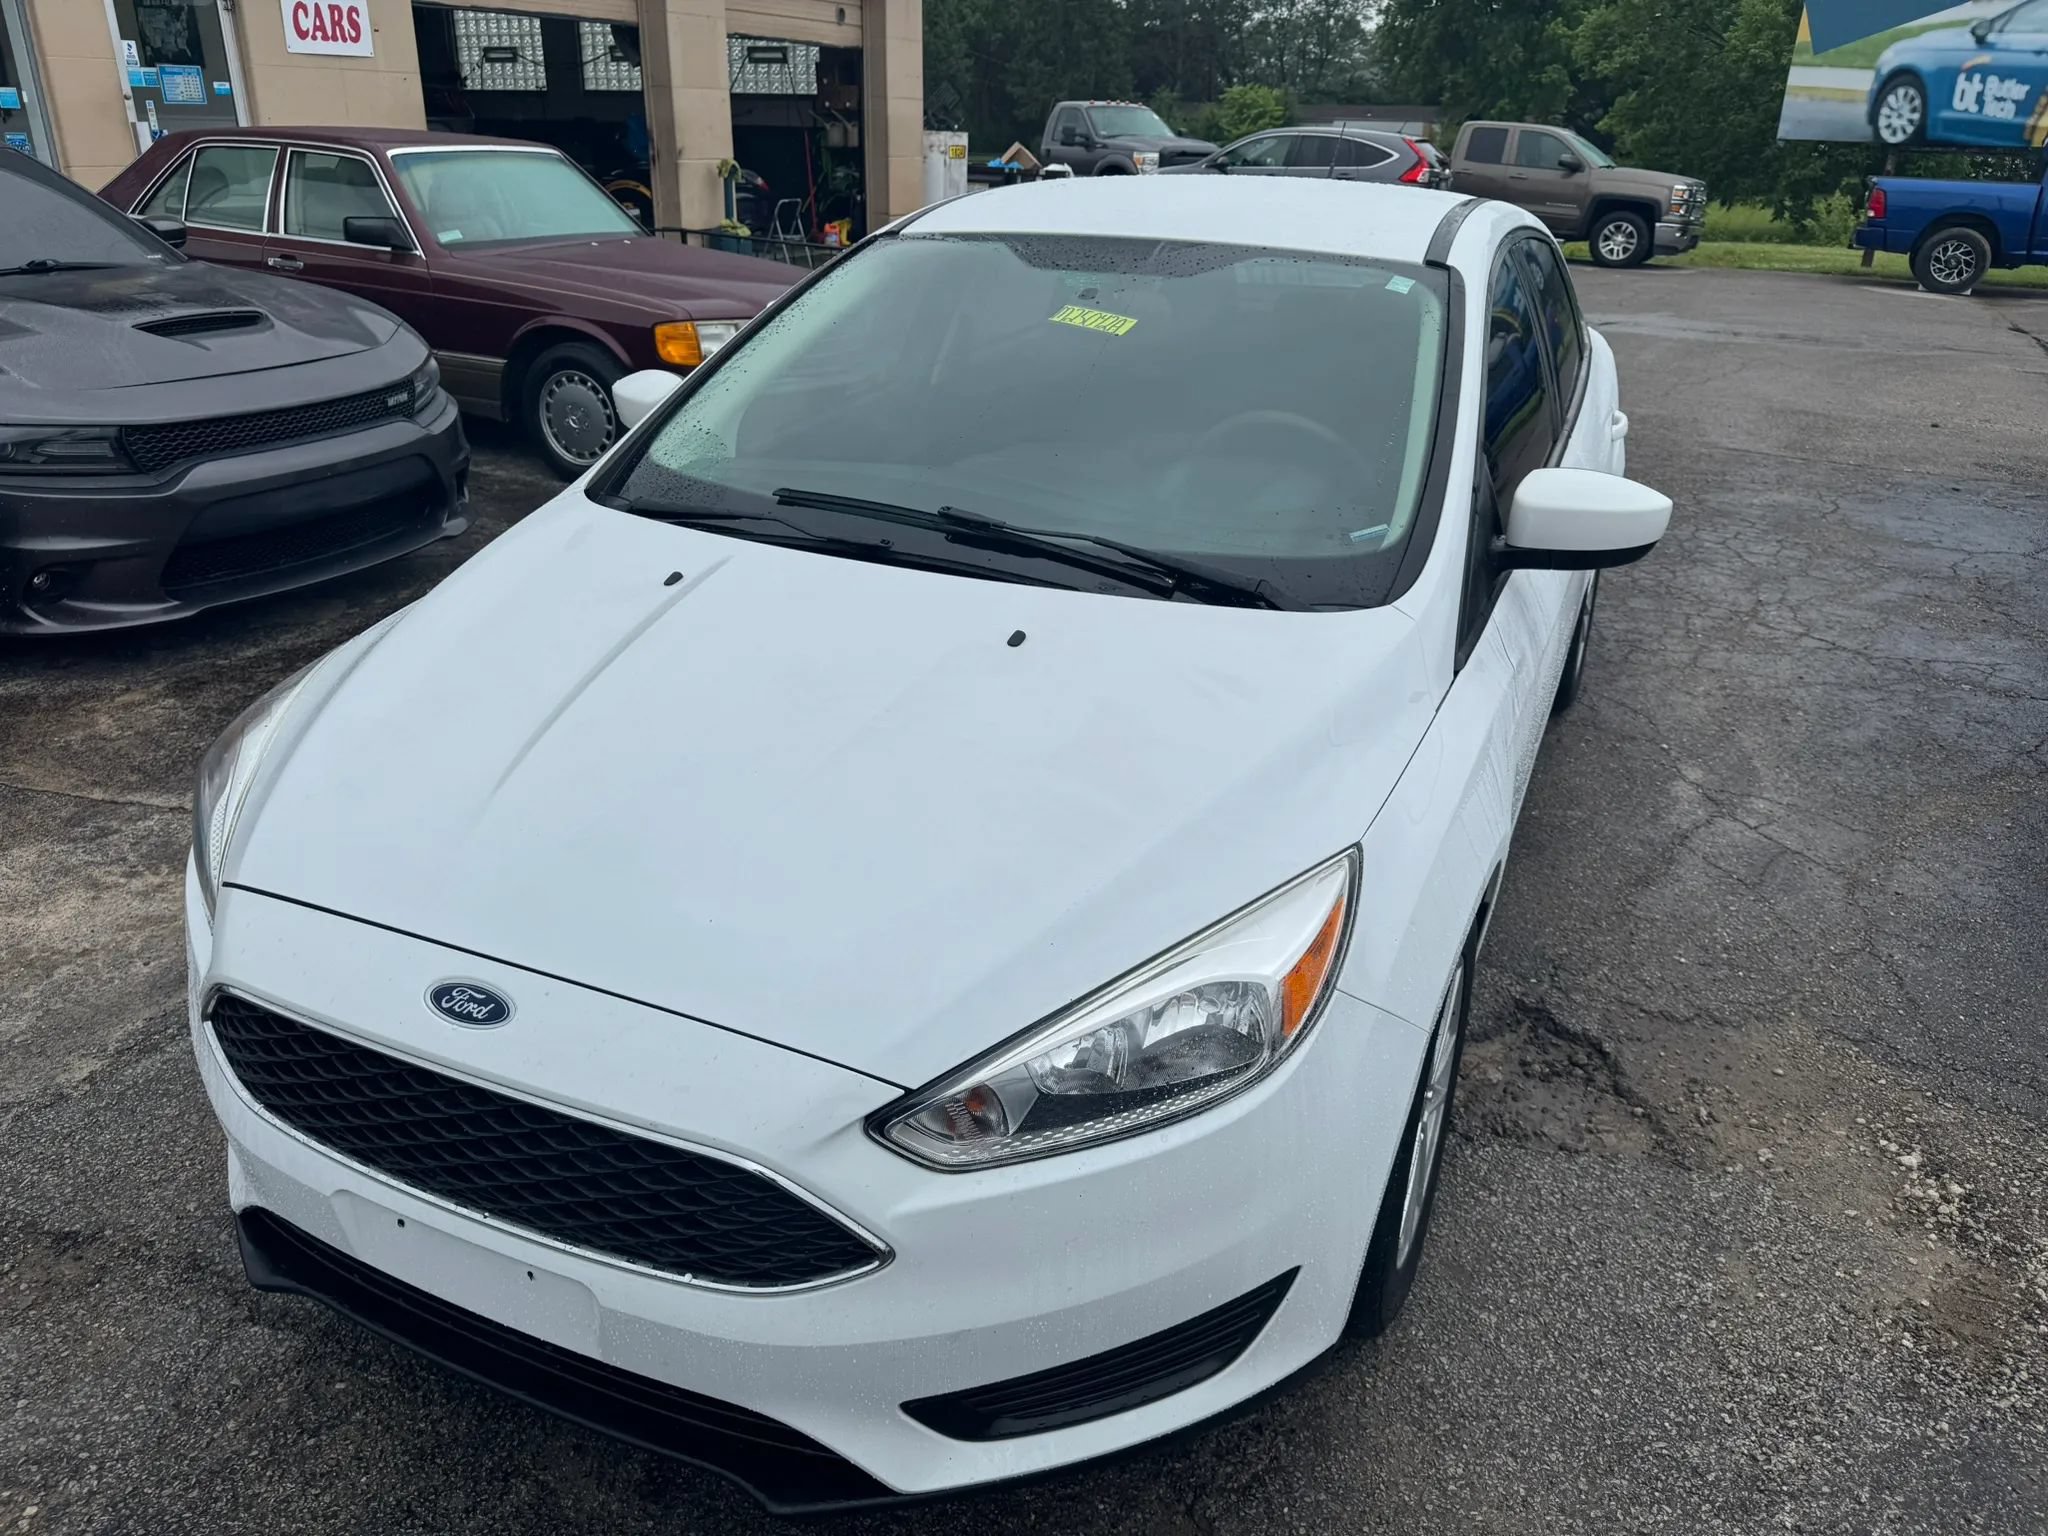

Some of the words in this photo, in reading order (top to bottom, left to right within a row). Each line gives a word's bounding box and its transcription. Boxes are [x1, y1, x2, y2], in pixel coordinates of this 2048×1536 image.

[293, 1, 361, 43] CARS
[1953, 72, 1983, 113] bt
[441, 987, 495, 1019] Ford
